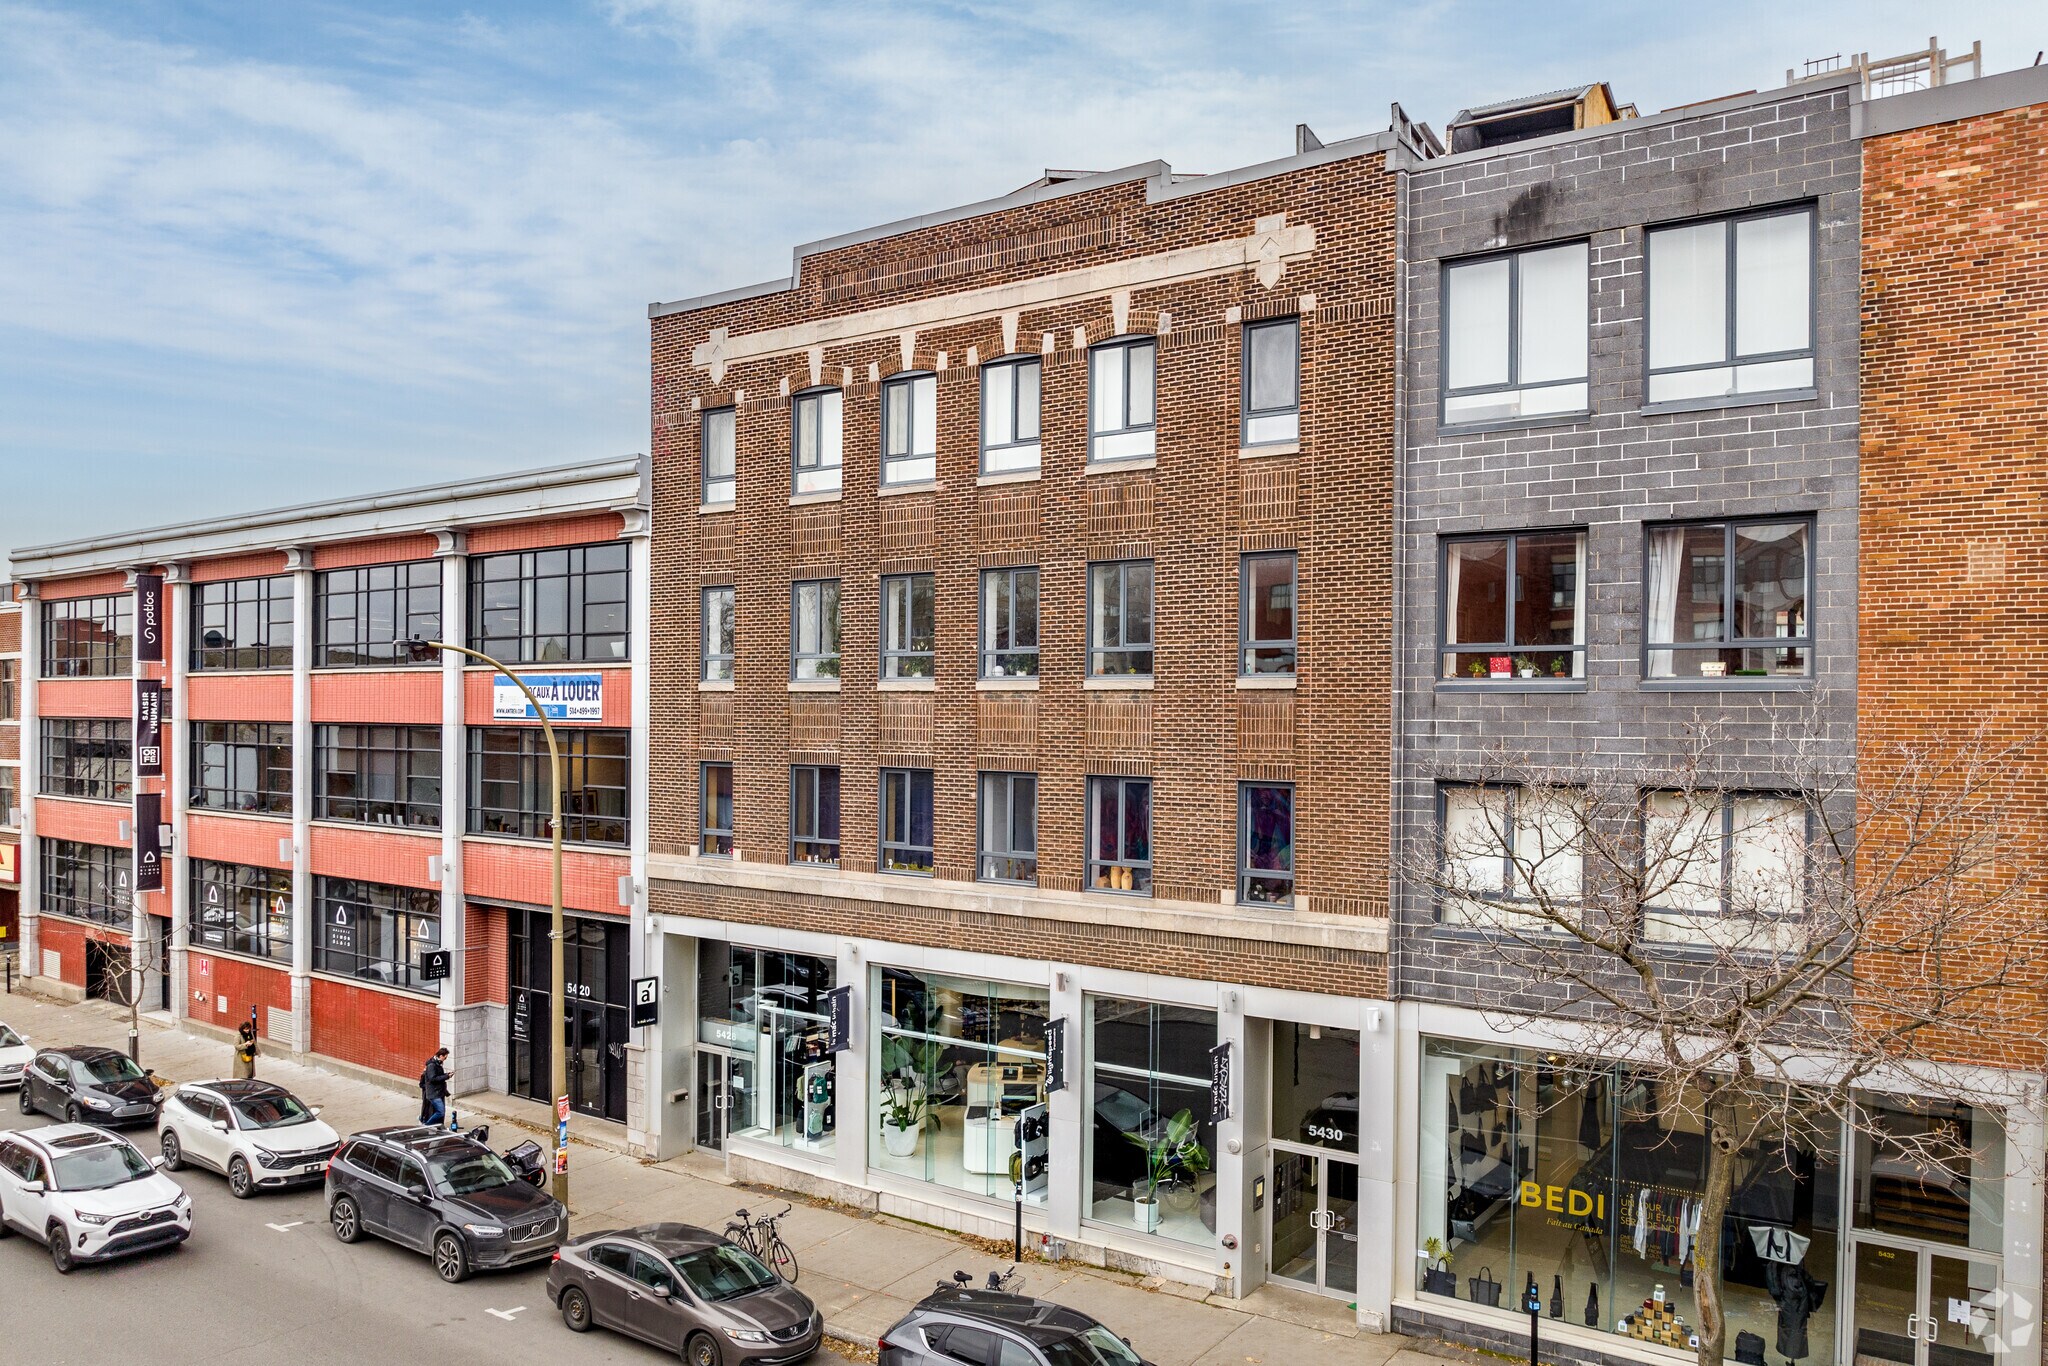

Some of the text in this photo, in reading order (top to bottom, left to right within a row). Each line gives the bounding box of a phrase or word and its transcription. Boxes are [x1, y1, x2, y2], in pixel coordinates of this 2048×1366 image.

[143, 591, 157, 626] potloc
[551, 678, 559, 701] À
[563, 681, 600, 701] LOUER
[141, 692, 149, 721] SAISIR
[150, 692, 158, 734] L'HUMAIN
[1308, 1124, 1343, 1142] 5430
[1520, 1180, 1605, 1220] BEDI
[1620, 1198, 1635, 1208] UN
[1546, 1217, 1604, 1235] Fait au Canada
[1878, 1250, 1895, 1260] 5432
